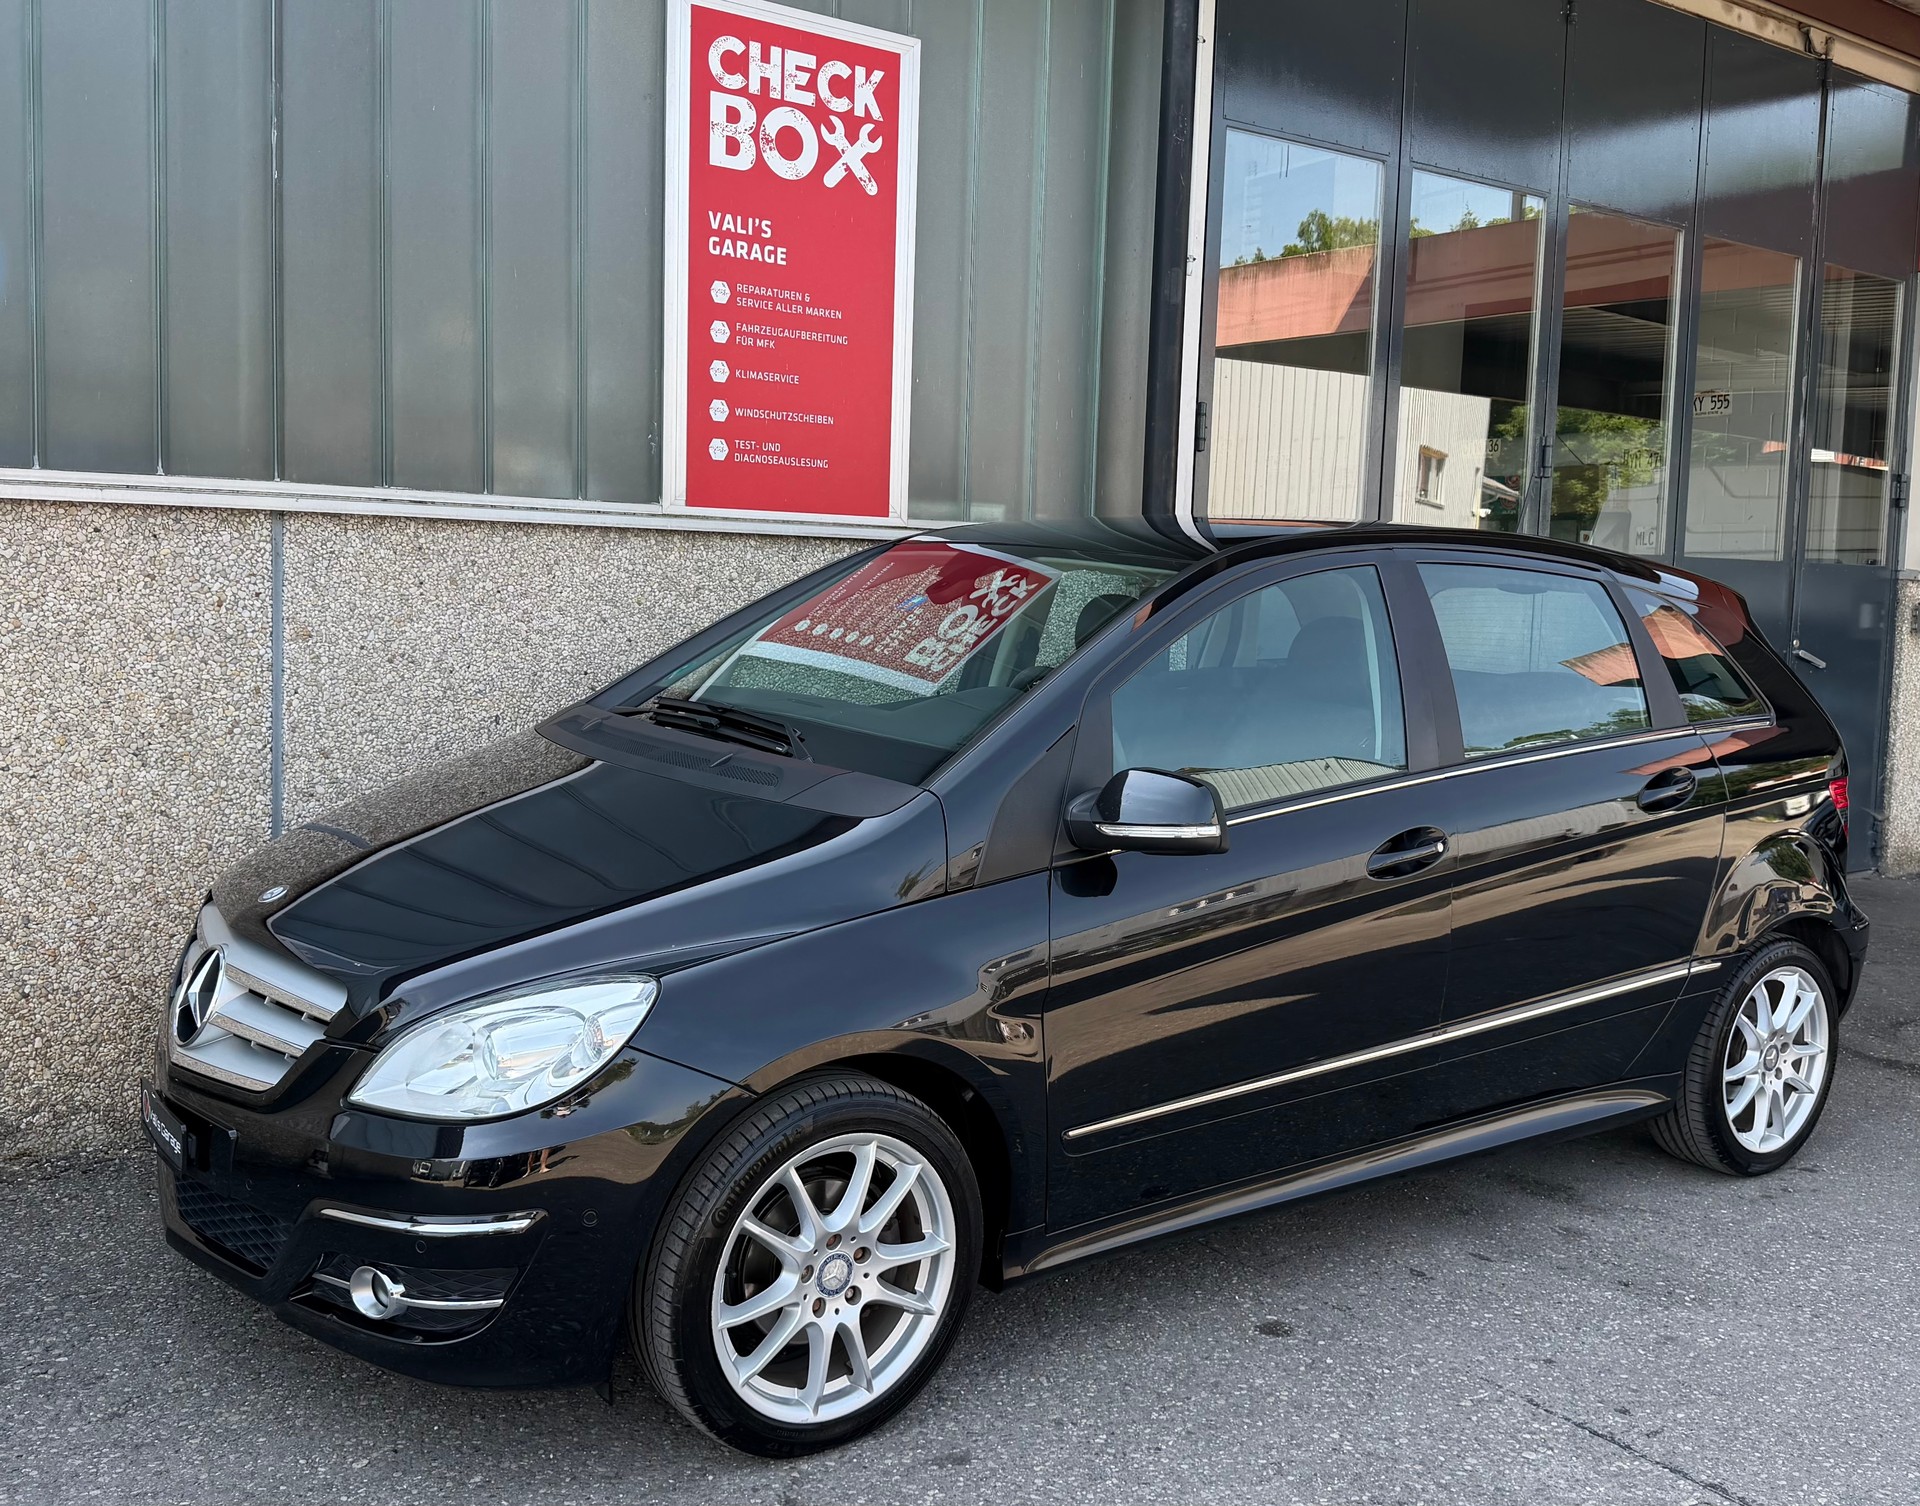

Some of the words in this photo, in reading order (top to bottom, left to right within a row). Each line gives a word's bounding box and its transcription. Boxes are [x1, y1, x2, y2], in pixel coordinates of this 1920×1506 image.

[707, 35, 885, 122] CHECK
[709, 90, 883, 196] BOX
[708, 210, 773, 239] VALI'S
[708, 236, 787, 266] GARAGE
[736, 283, 803, 301] REPARATUREN
[804, 293, 811, 303] &
[736, 296, 774, 311] SERVICE
[775, 302, 803, 315] ALLER
[805, 306, 842, 320] MARKEN
[735, 335, 754, 347] FÜR
[756, 338, 776, 349] MFK
[736, 322, 848, 345] FAHRZEUGAUFBEREITUNG
[735, 369, 800, 384] KLIMASERVICE
[1710, 393, 1730, 411] 555
[734, 407, 834, 425] WINDSCHUTZSCHEIBEN
[734, 439, 760, 451] TEST-
[762, 442, 781, 452] UND
[1488, 439, 1500, 453] 36
[734, 452, 829, 469] DIAGNOSEAUSLESUNG
[1635, 530, 1655, 547] MLC
